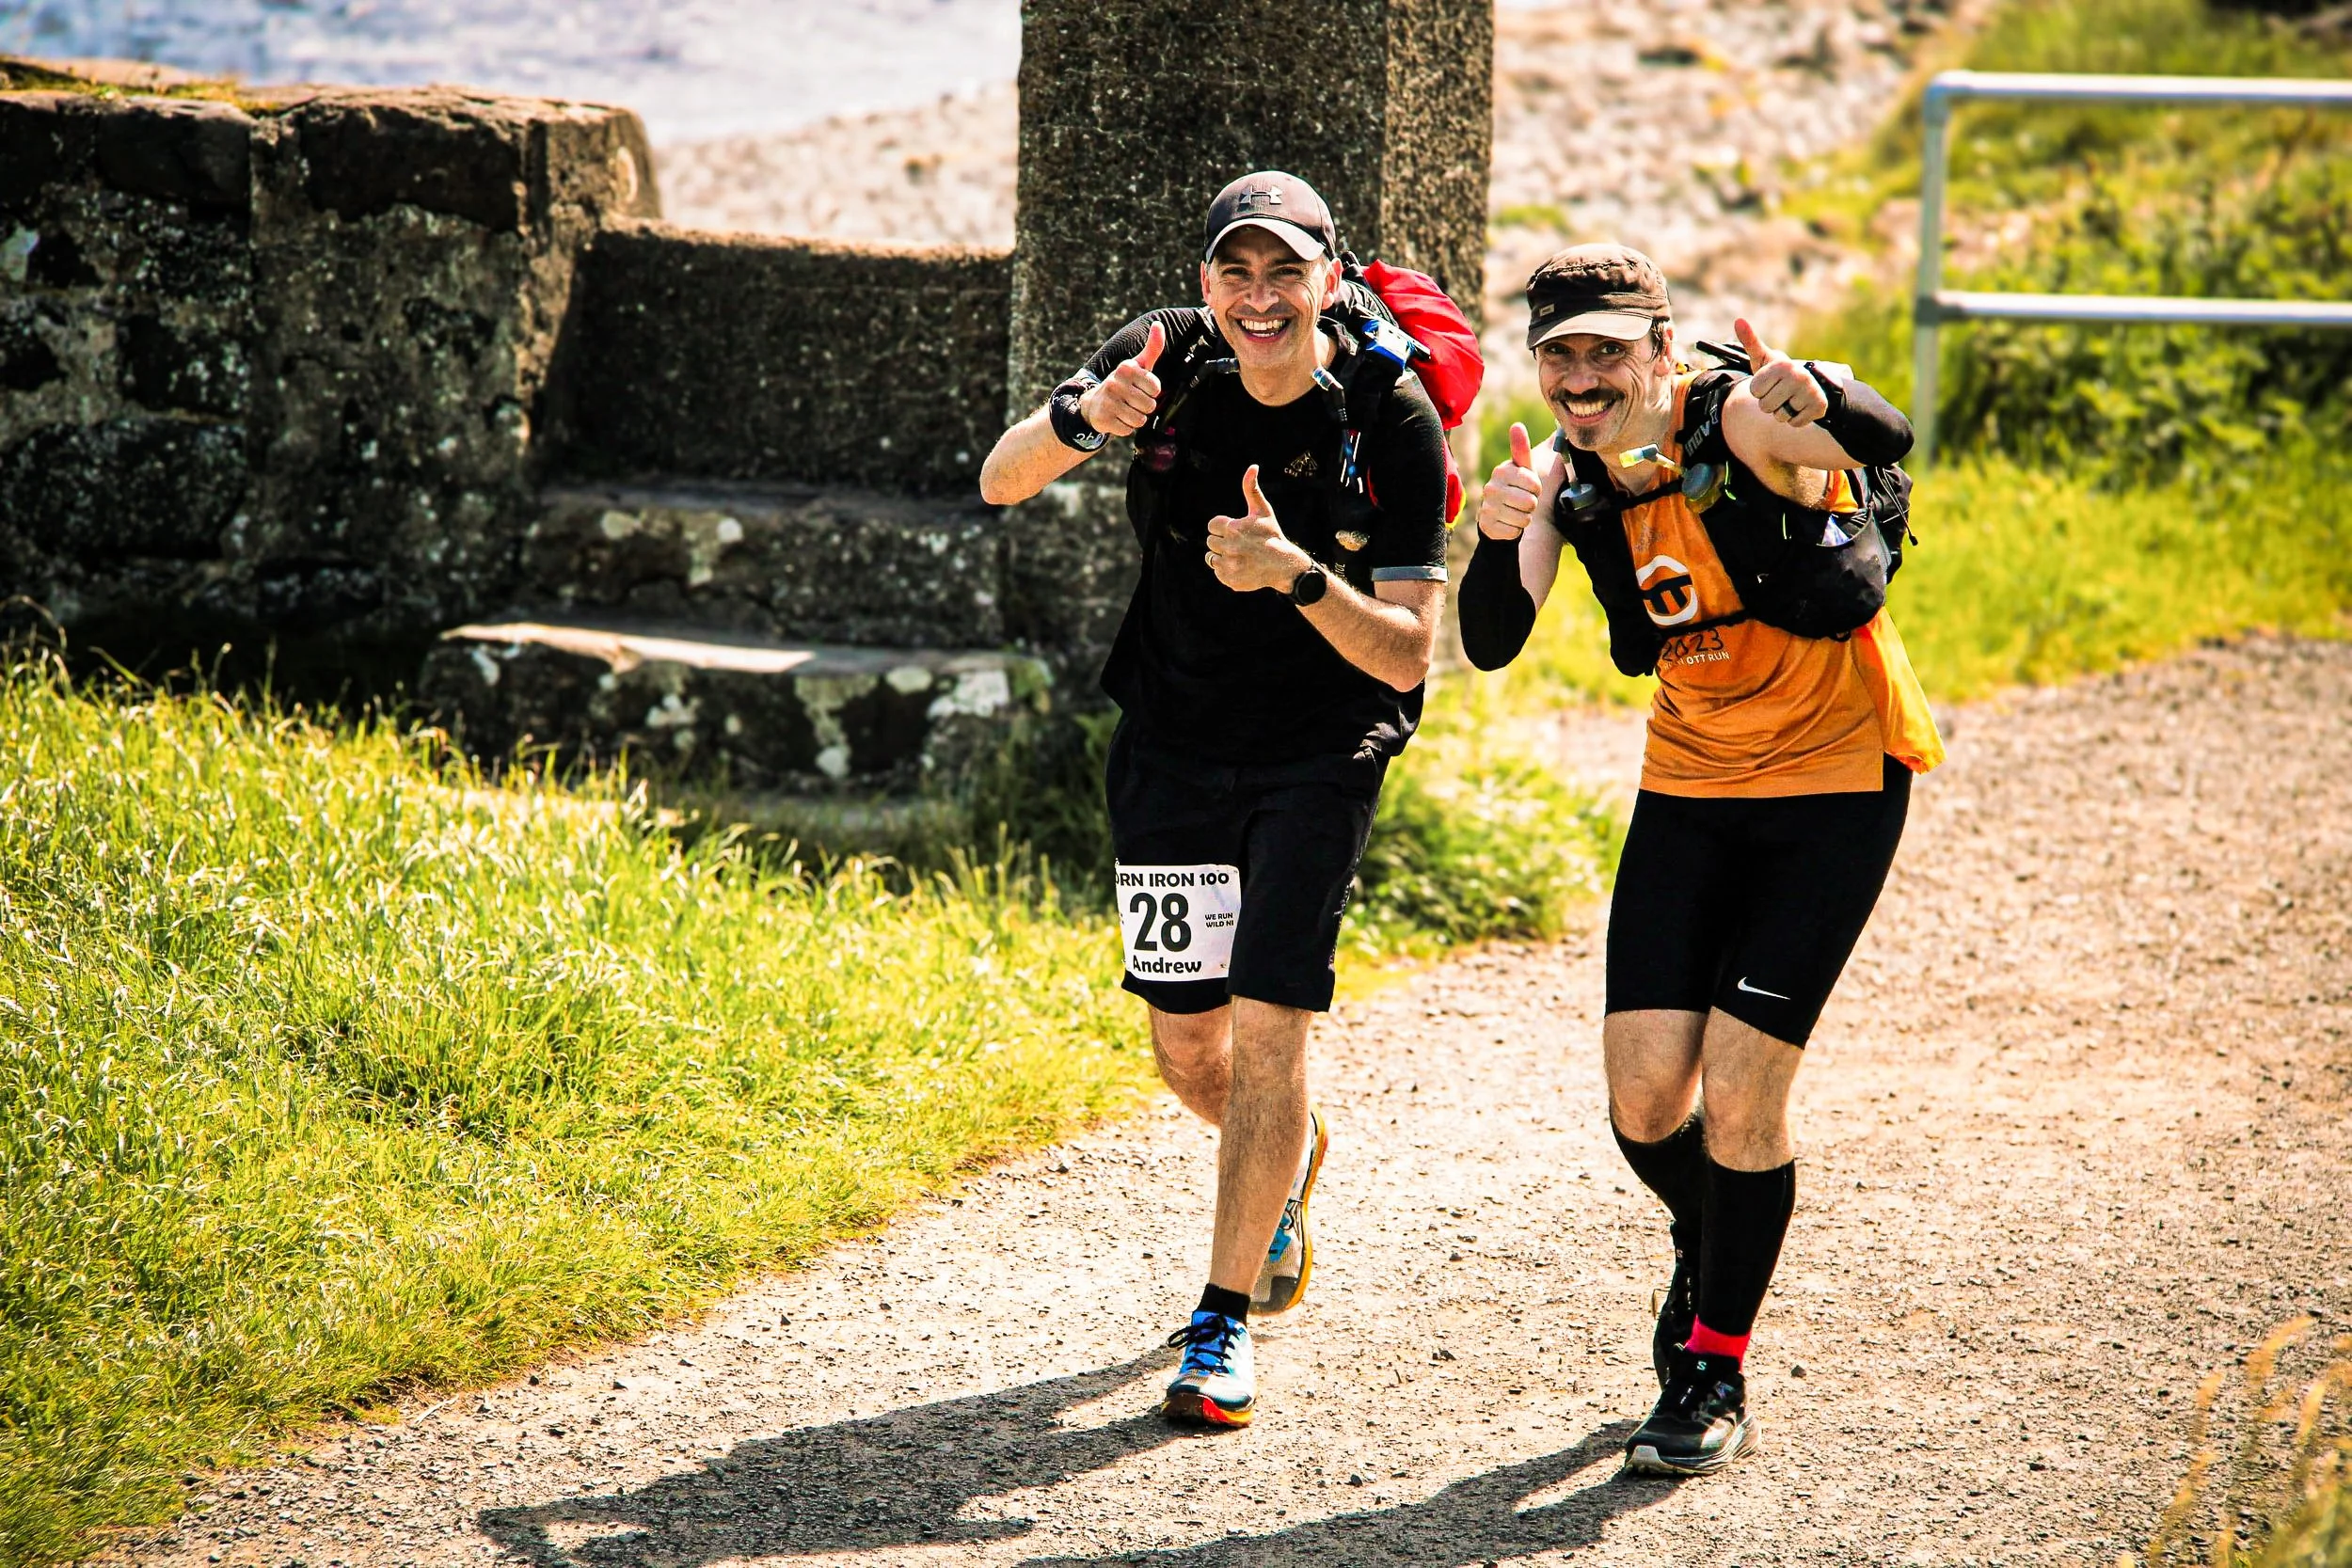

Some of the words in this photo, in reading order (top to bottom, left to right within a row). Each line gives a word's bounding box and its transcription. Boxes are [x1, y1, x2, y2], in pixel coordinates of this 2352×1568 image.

[1661, 627, 1724, 662] 2023
[1708, 651, 1730, 662] RUN
[1149, 873, 1195, 887] IRON
[1199, 872, 1230, 886] 100
[1129, 892, 1192, 953] 28
[1133, 955, 1202, 974] Andrew
